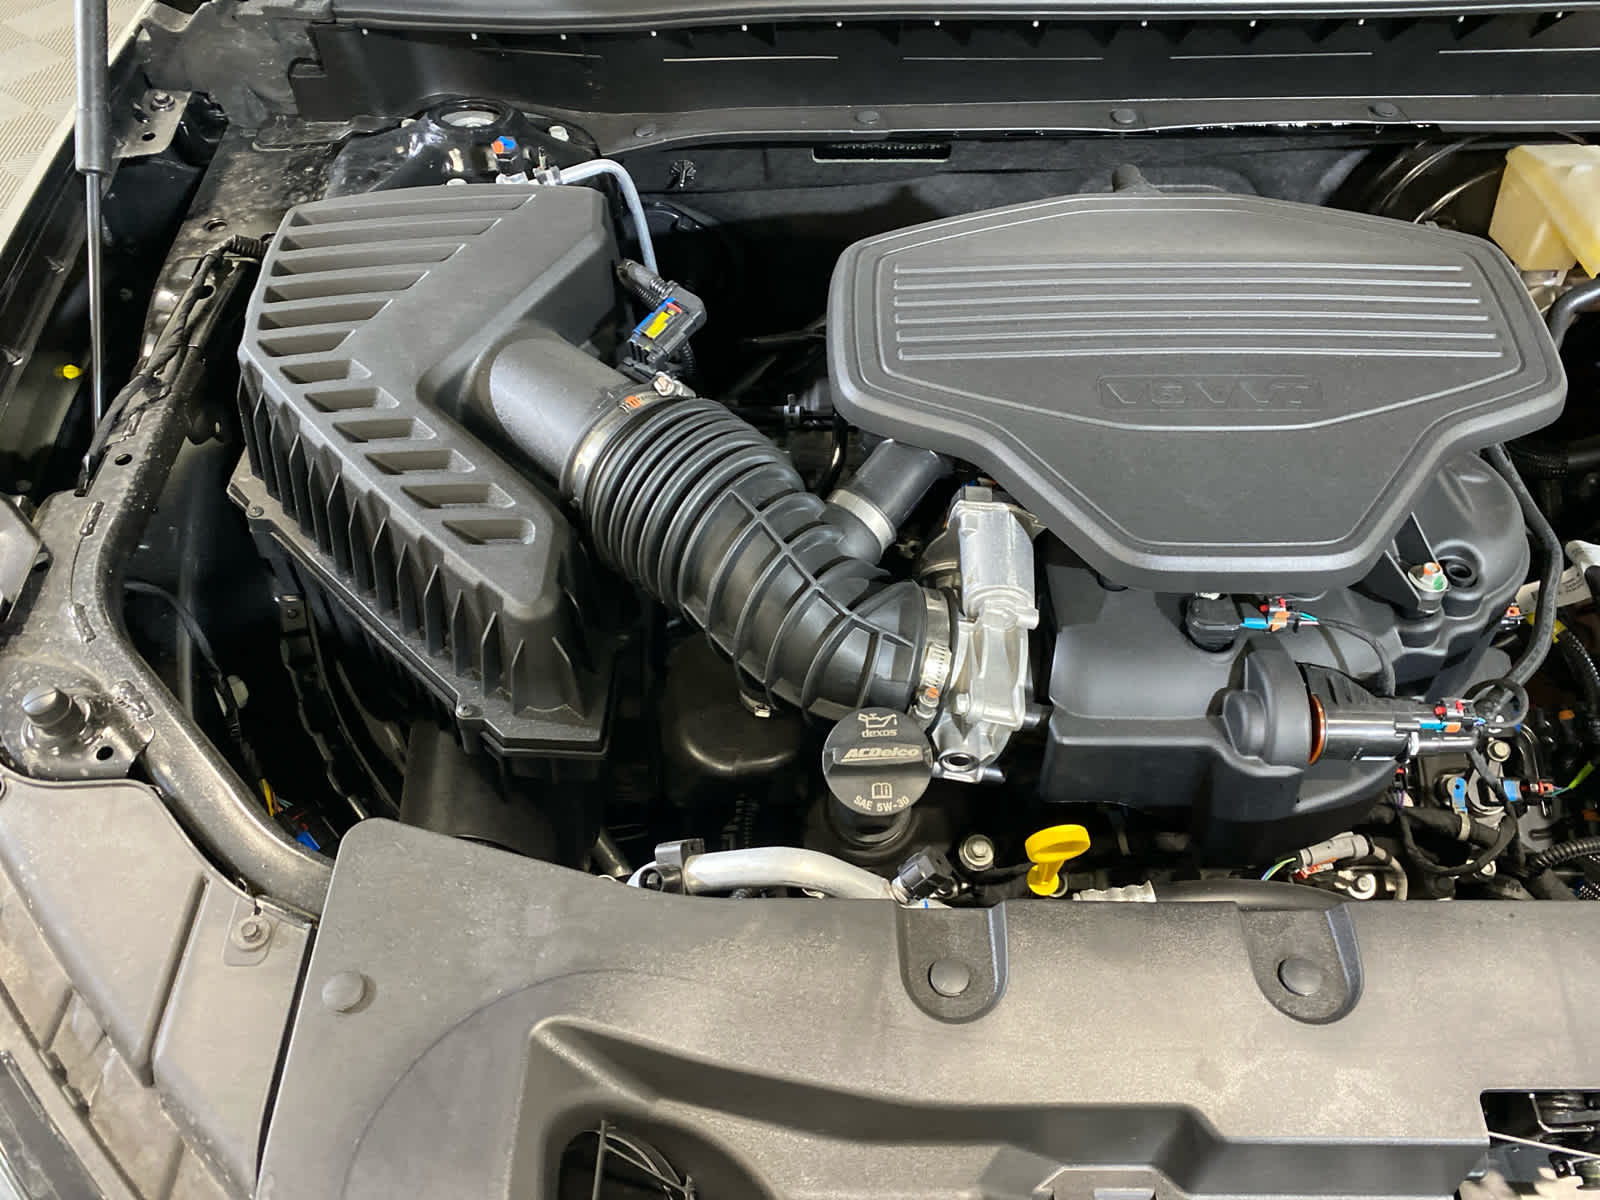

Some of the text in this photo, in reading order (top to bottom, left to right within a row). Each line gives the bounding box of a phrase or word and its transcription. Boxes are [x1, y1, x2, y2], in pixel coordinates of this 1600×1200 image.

[861, 729, 898, 738] dexos
[843, 747, 919, 759] ACDelco
[854, 795, 910, 812] SAE 5W-30
